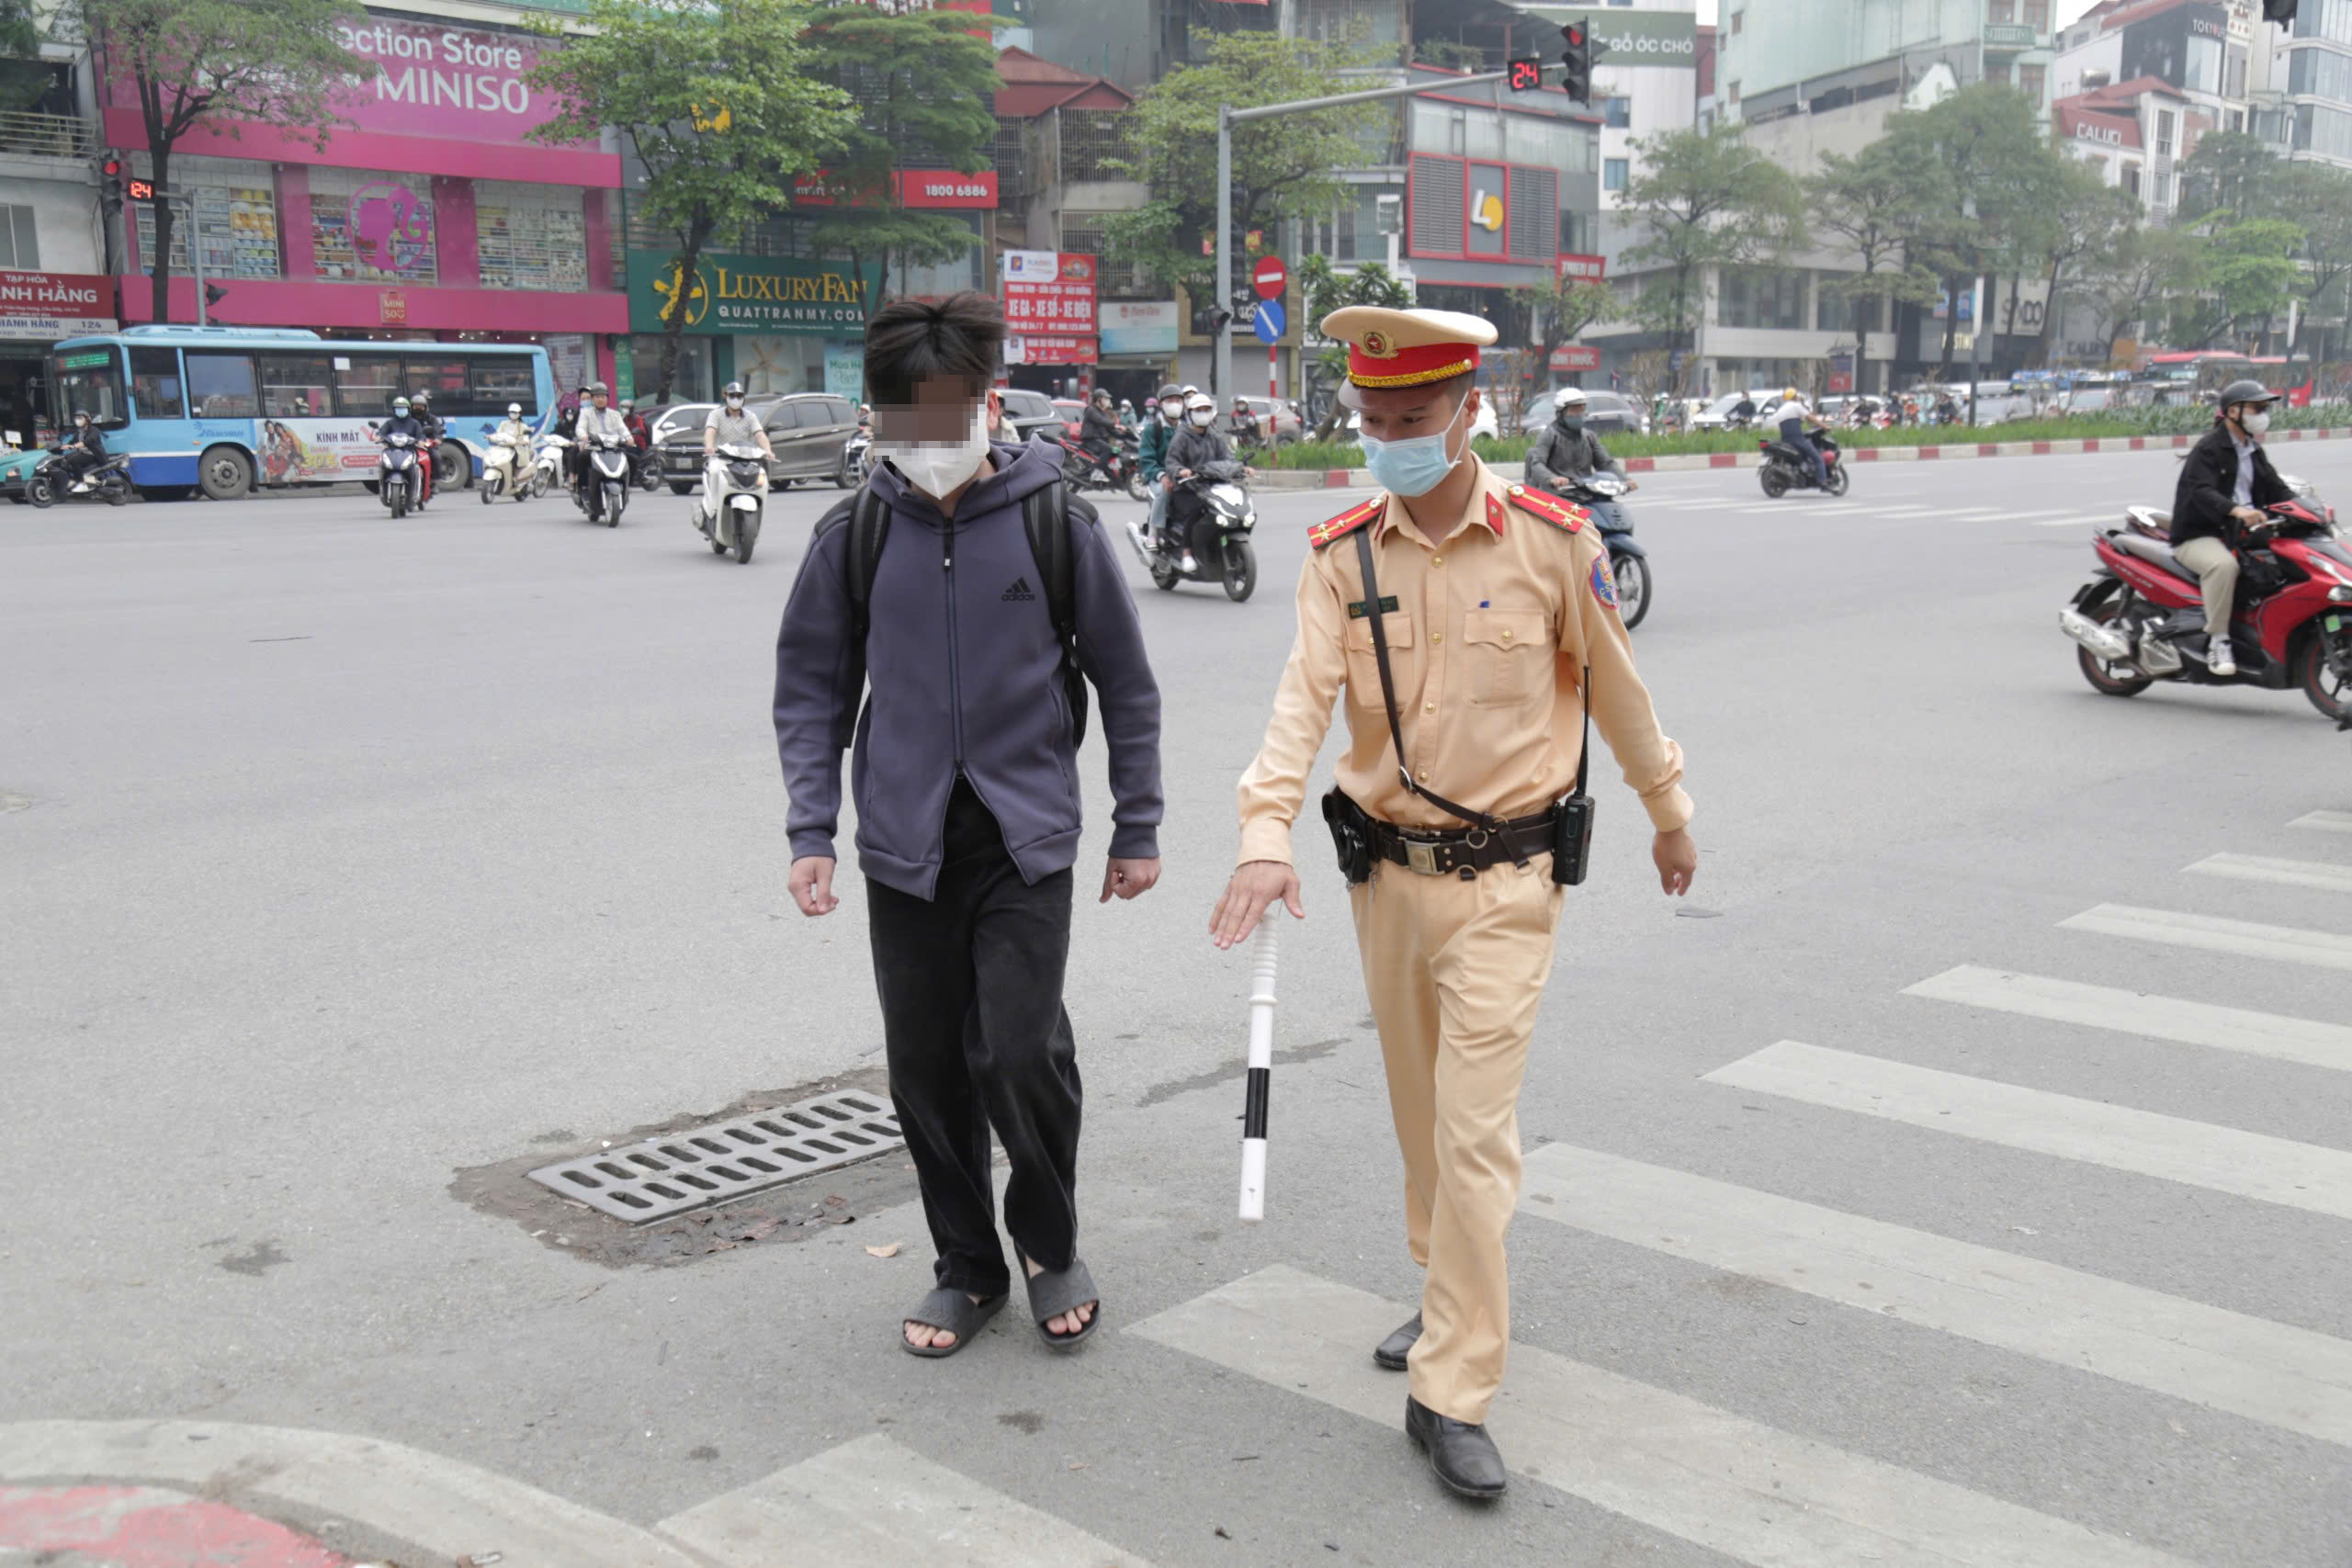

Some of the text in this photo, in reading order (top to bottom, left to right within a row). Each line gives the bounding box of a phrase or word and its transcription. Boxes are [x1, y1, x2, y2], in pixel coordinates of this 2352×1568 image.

[328, 24, 523, 70] ection Store
[1610, 30, 1633, 52] GỖ
[1635, 35, 1659, 52] ÓC
[1661, 35, 1694, 54] CHÓ
[1512, 62, 1539, 89] 24
[376, 62, 530, 115] MINISO
[2075, 121, 2122, 147] CALUCI
[130, 182, 153, 199] 124
[924, 185, 989, 197] 1800 6886
[0, 286, 33, 301] NH
[1009, 299, 1019, 317] XE
[1036, 299, 1046, 318] XE
[1064, 300, 1073, 318] XE
[81, 321, 102, 329] 124
[1001, 593, 1036, 602] adidas
